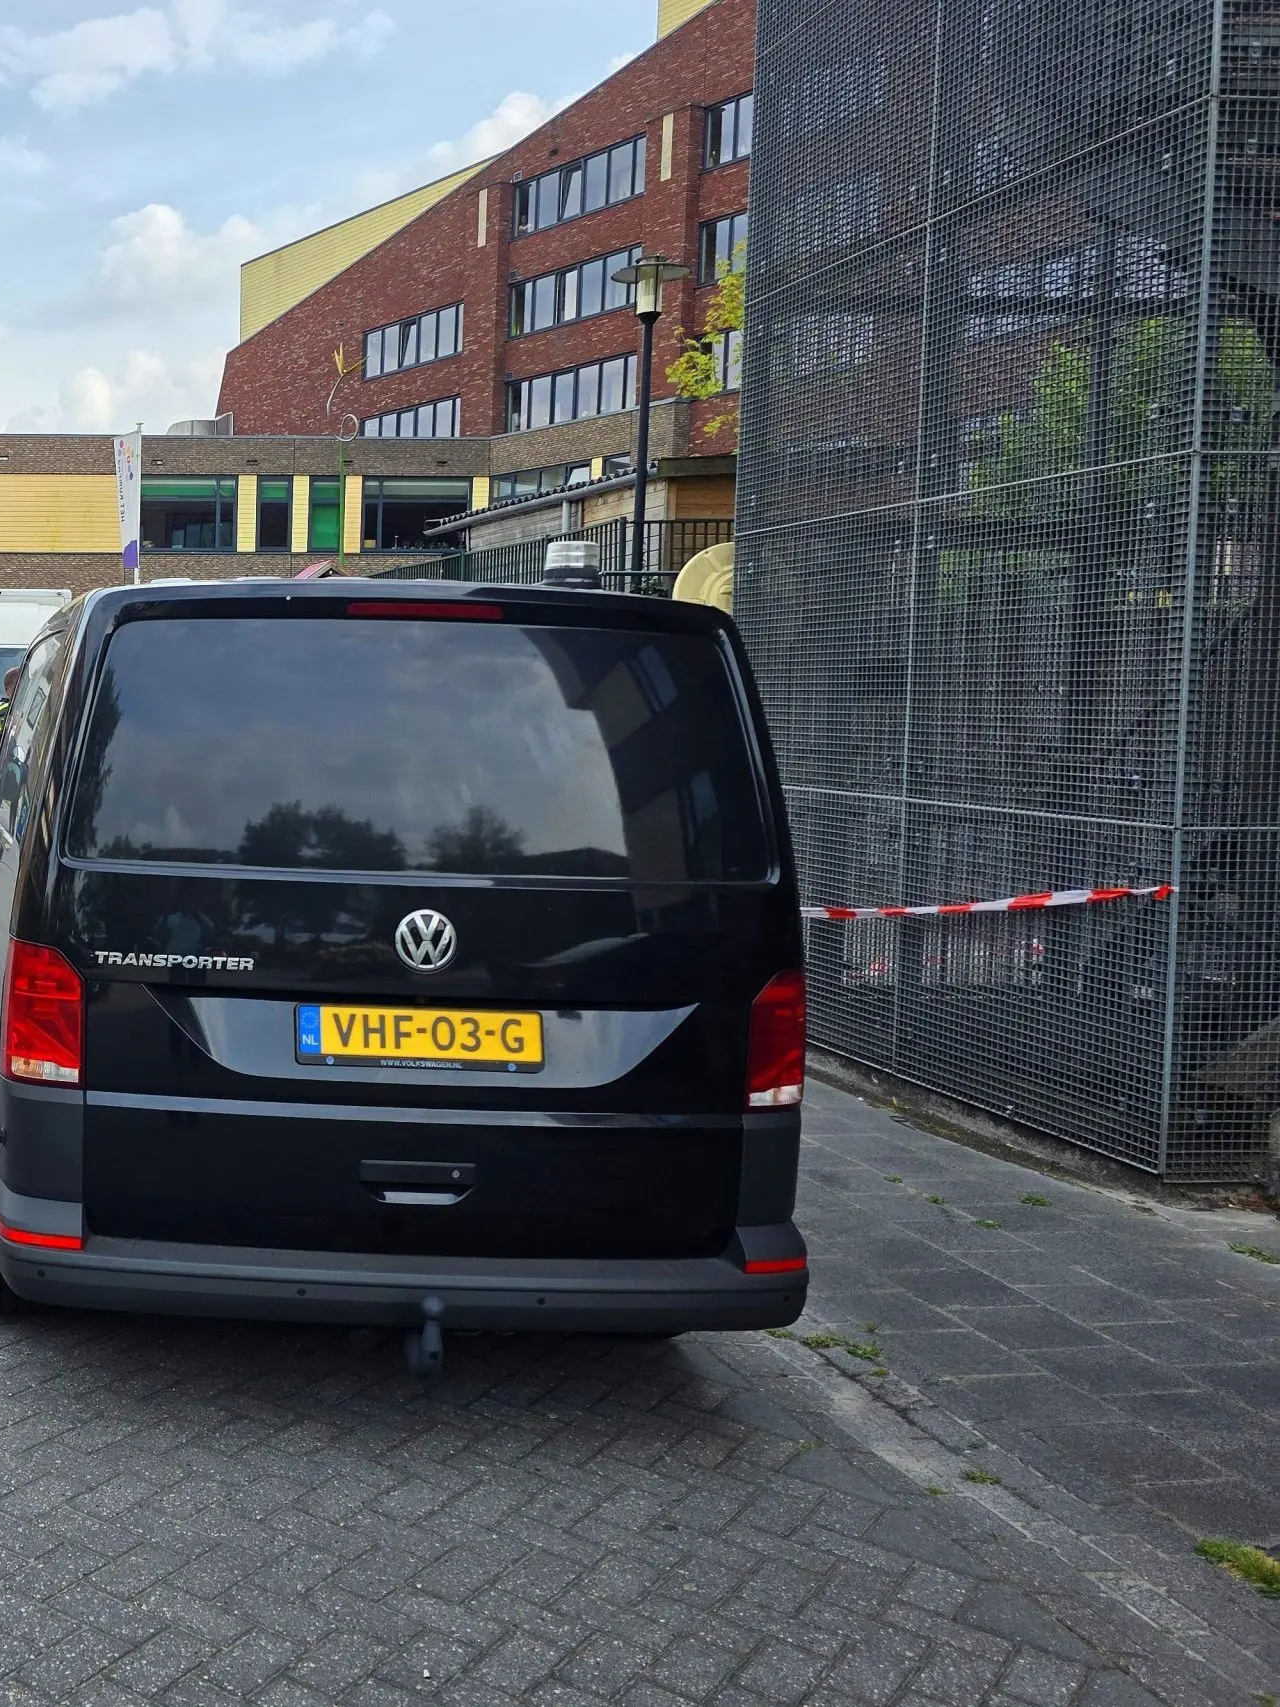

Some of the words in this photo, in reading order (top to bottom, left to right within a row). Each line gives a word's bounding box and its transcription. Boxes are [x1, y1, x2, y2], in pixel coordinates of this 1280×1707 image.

[94, 950, 255, 972] TRANSPORTER
[302, 1034, 318, 1046] NL
[331, 1011, 525, 1054] VHF-03-G
[380, 1059, 463, 1069] WWW.VOLKSWAGEN.NL
